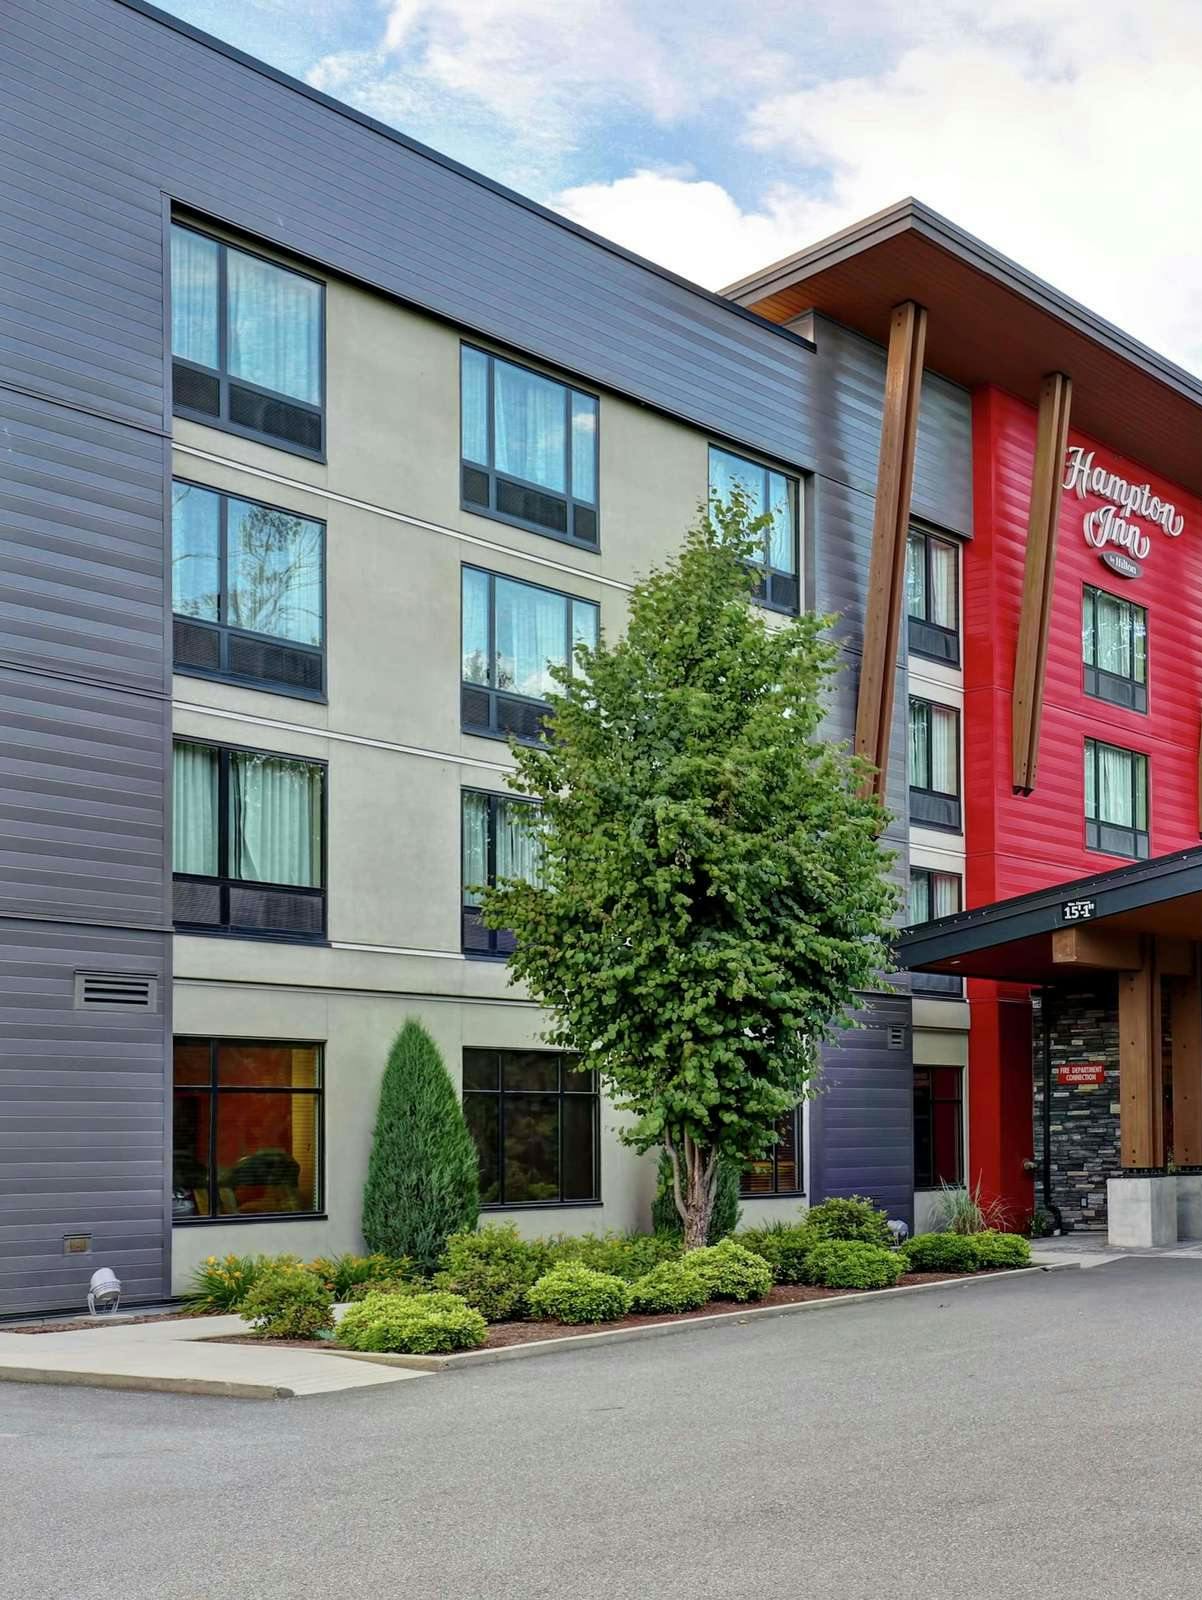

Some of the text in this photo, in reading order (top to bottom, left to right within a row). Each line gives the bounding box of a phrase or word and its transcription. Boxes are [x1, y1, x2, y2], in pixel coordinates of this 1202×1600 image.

[1062, 446, 1184, 537] Hampton
[1085, 505, 1150, 559] Inn
[1071, 1066, 1102, 1074] DEPARTMENT
